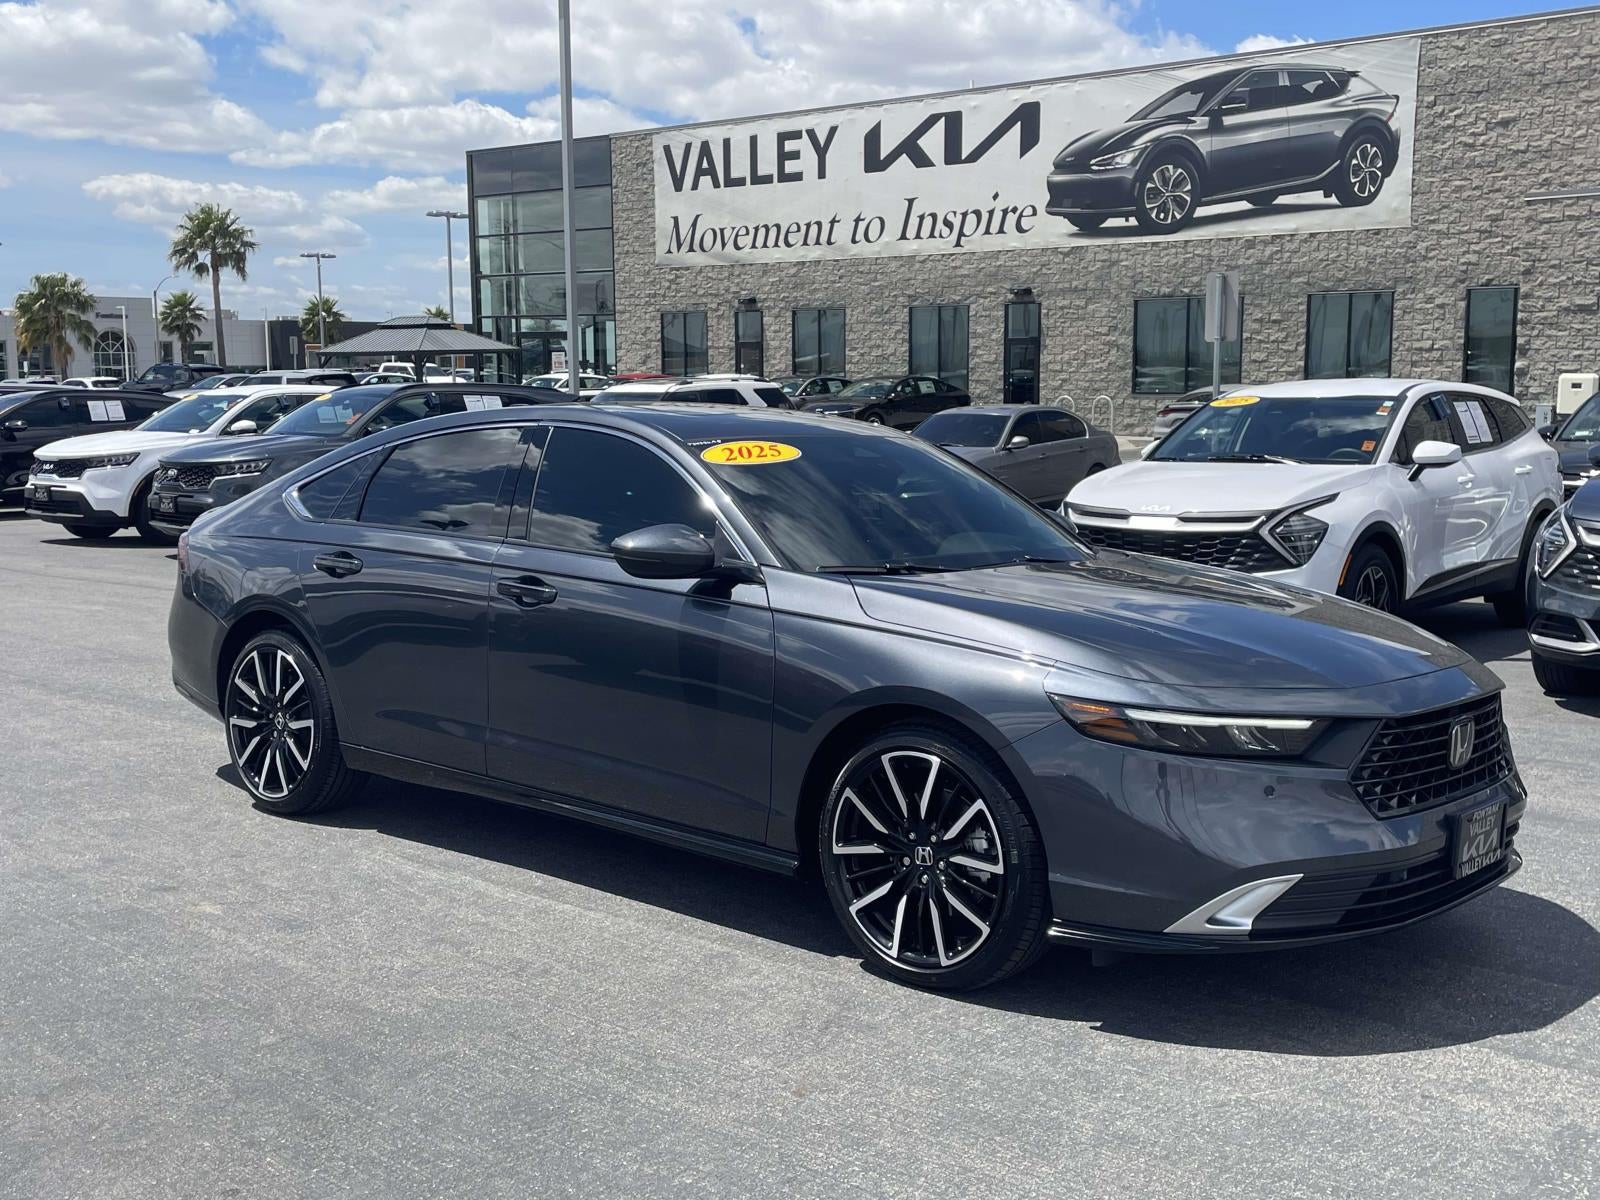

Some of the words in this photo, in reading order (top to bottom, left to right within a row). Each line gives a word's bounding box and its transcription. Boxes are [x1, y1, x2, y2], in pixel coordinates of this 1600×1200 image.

[663, 125, 839, 193] VALLEY
[864, 101, 1041, 173] KIA
[665, 211, 841, 255] Movement
[851, 212, 886, 244] to
[896, 191, 1038, 248] Inspire
[721, 444, 782, 462] 2025
[1469, 814, 1496, 837] VALLEY
